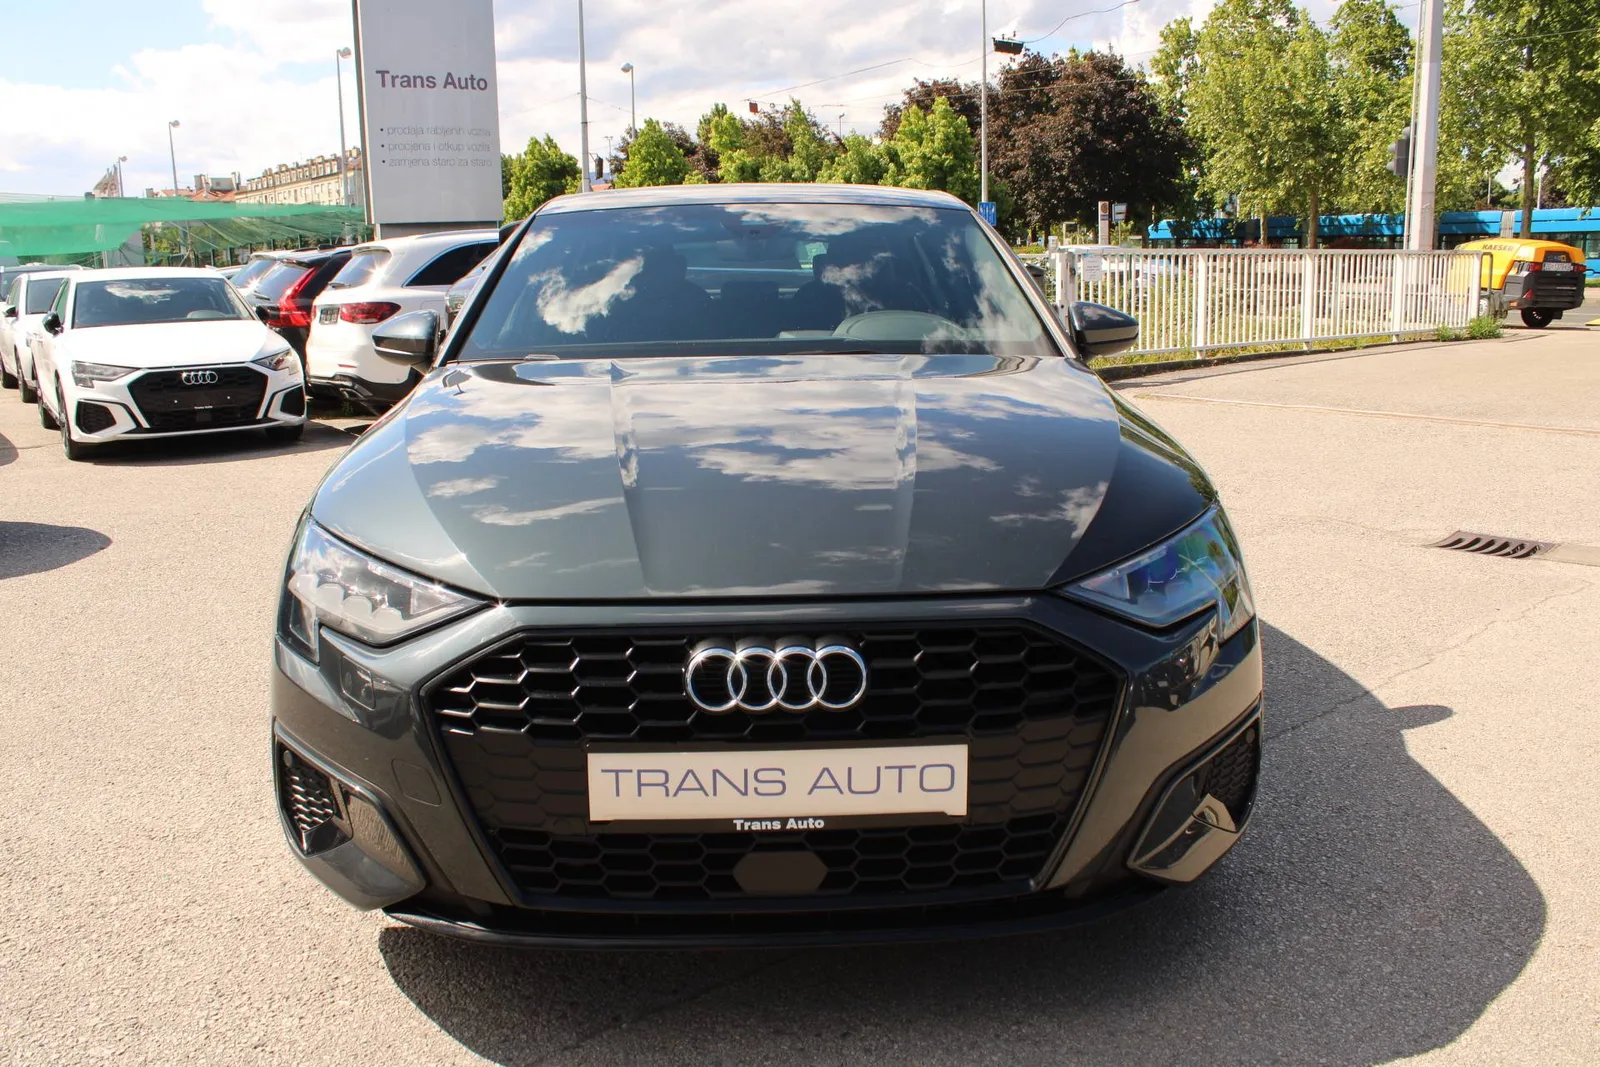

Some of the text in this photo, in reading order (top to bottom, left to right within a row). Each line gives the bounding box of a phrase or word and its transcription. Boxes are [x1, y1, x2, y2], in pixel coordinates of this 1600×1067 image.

[375, 70, 488, 91] Trans Auto
[387, 126, 424, 137] prodaja
[388, 141, 431, 153] procjena
[438, 142, 465, 153] otkup
[388, 157, 430, 168] zamjena
[457, 159, 469, 167] za
[1482, 243, 1514, 252] KAESER
[601, 763, 955, 798] TRANS AUTO
[733, 817, 825, 831] Trans Auto
